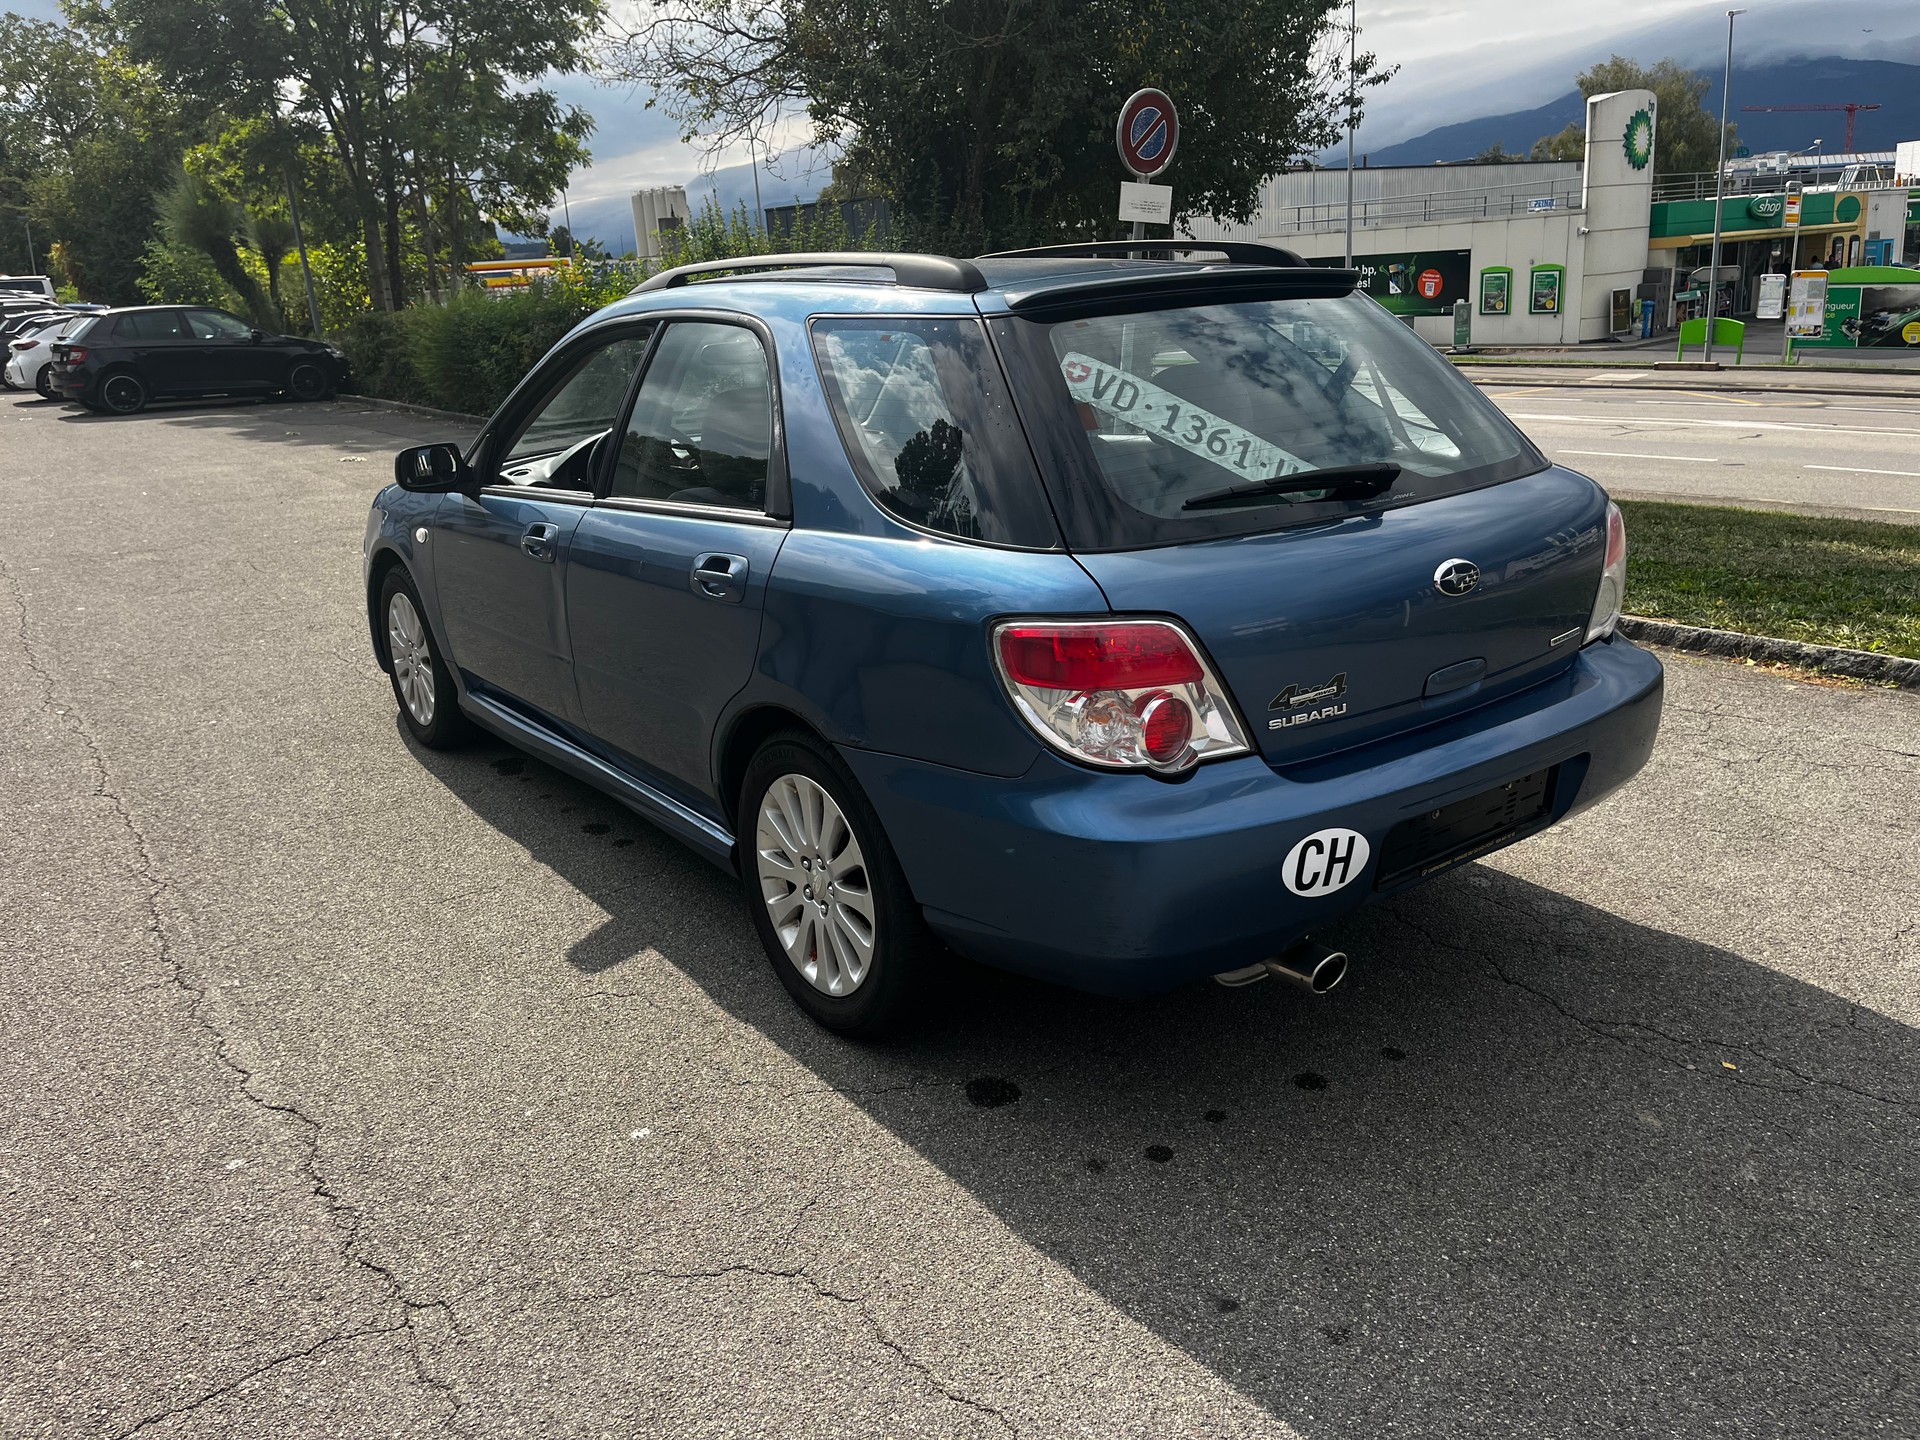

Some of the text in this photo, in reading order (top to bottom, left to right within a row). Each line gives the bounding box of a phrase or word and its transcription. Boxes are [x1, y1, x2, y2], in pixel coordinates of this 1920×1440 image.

[1648, 99, 1655, 115] bp
[1758, 197, 1781, 213] shop
[1356, 277, 1371, 288] es!
[1824, 303, 1856, 312] ngueur
[1267, 672, 1347, 711] 4x4
[1268, 703, 1347, 730] SUBARU
[1295, 835, 1356, 891] CH
